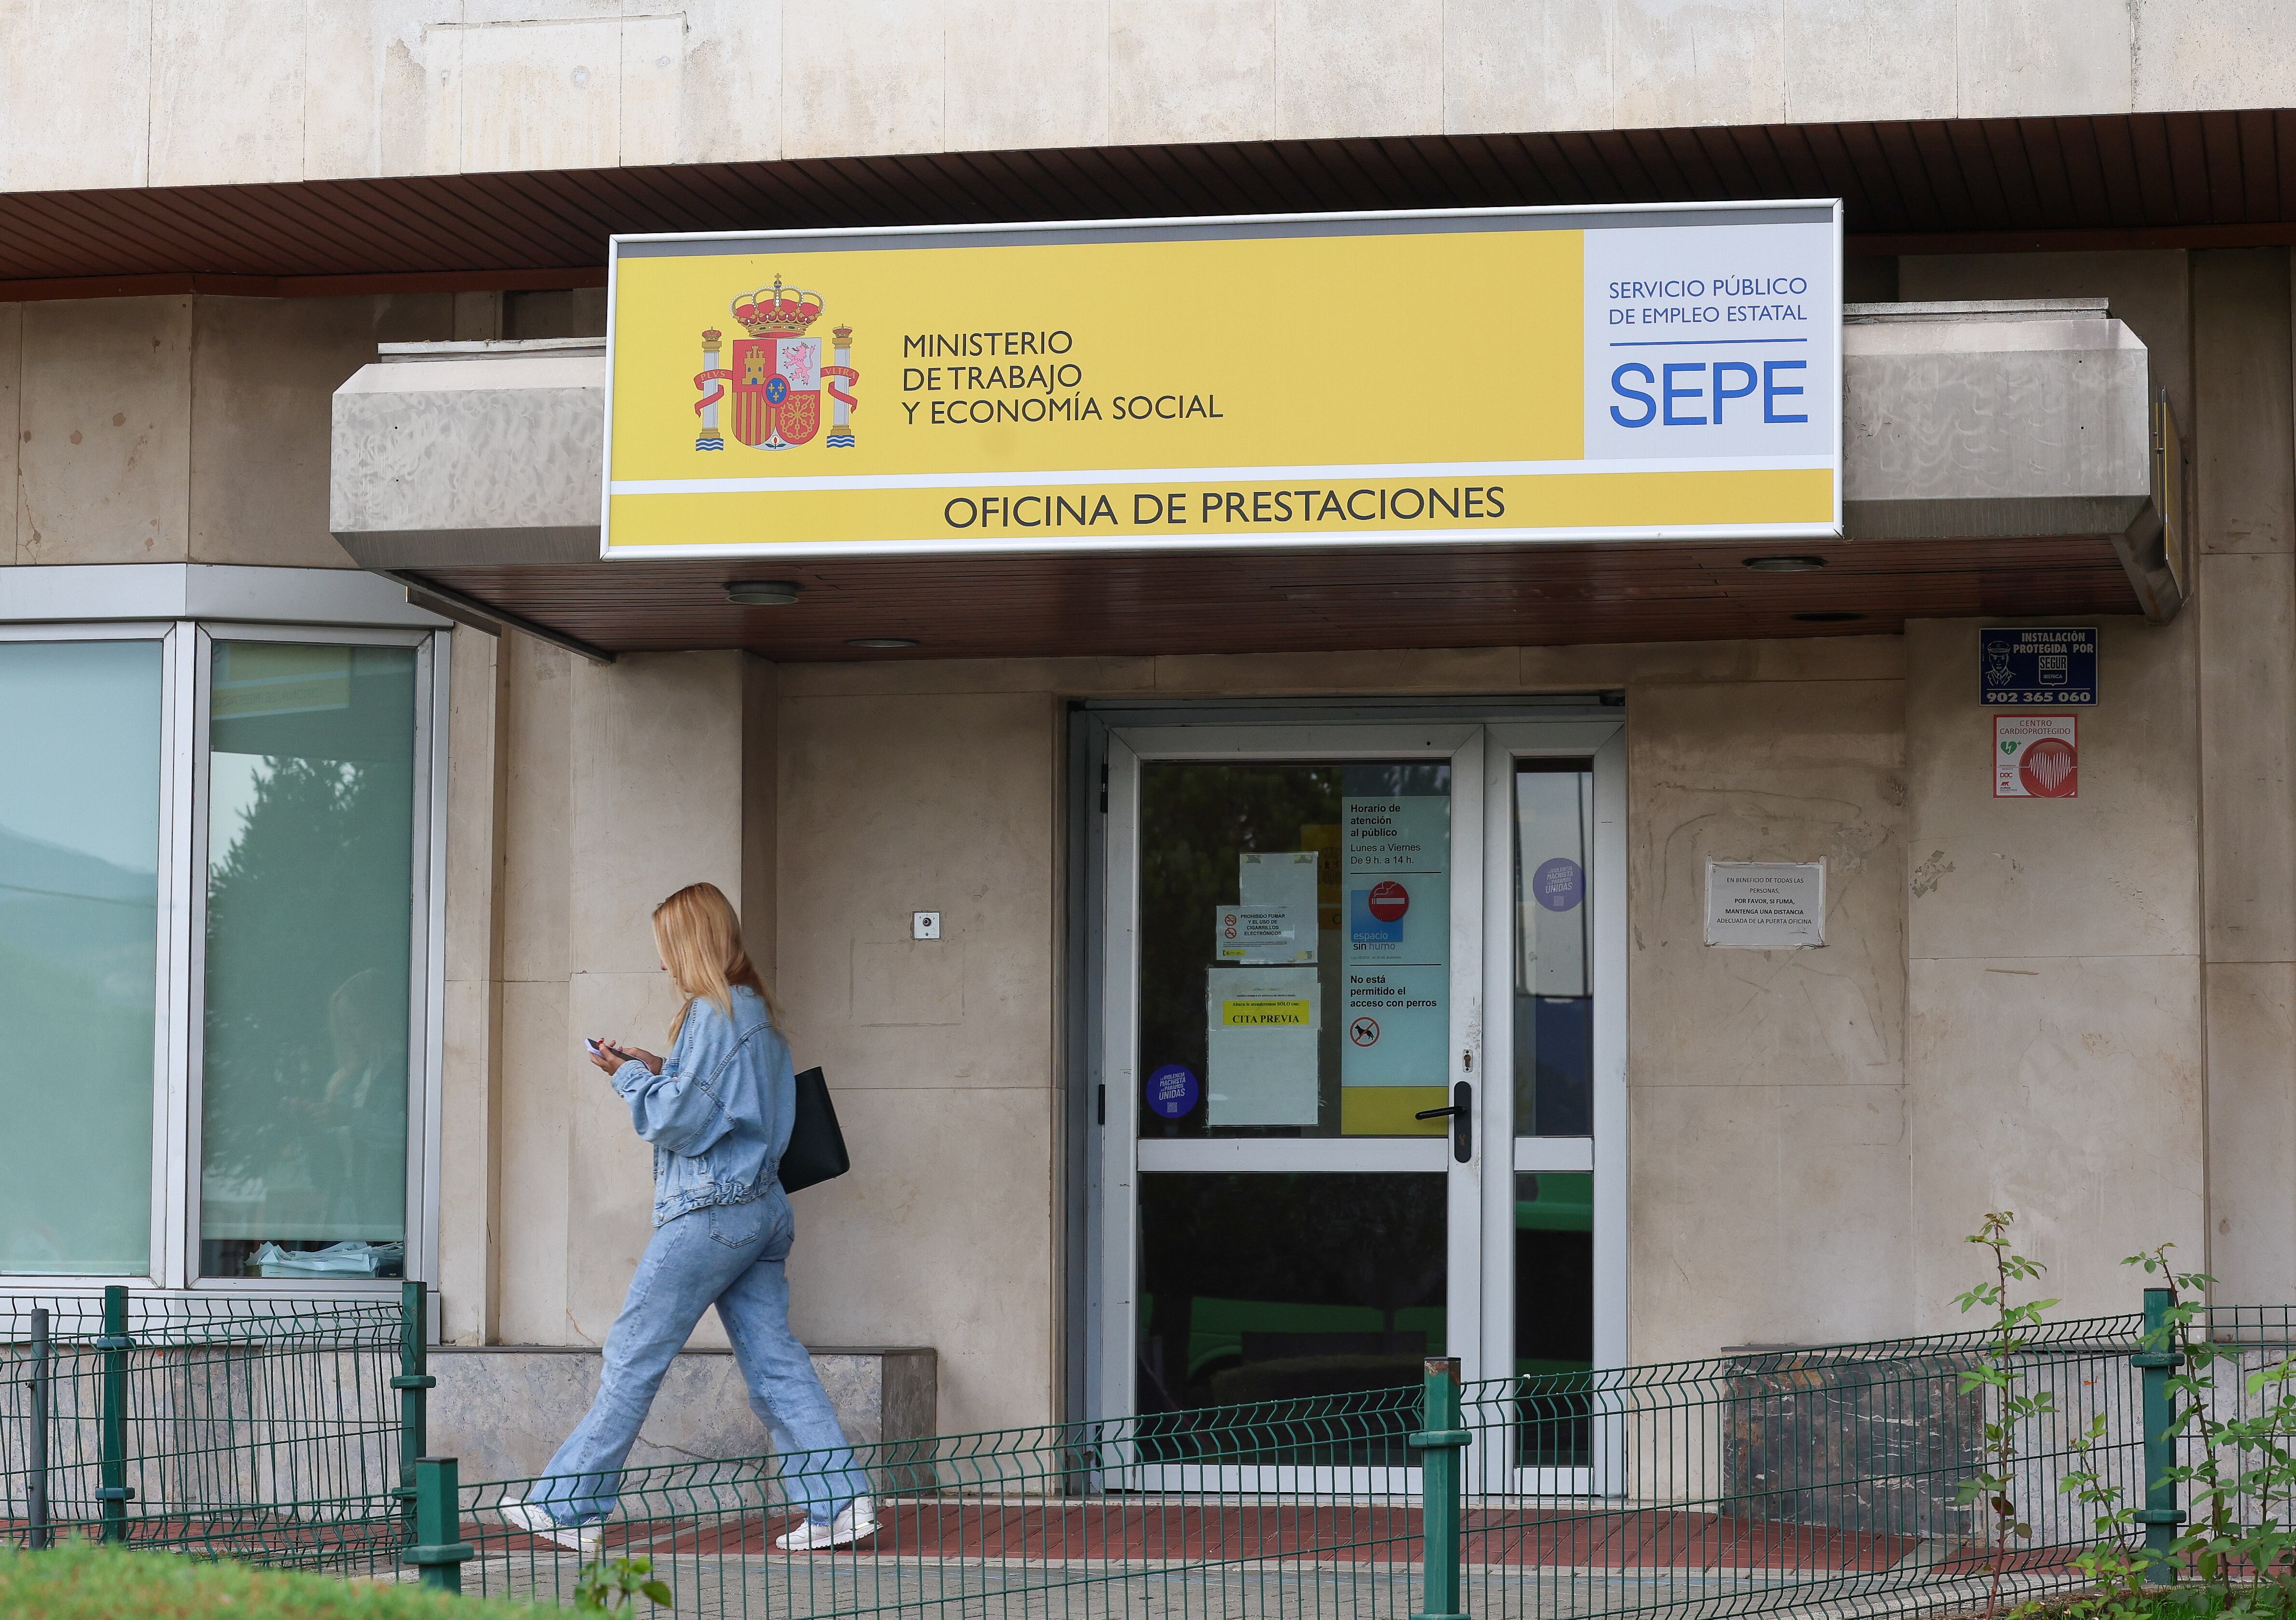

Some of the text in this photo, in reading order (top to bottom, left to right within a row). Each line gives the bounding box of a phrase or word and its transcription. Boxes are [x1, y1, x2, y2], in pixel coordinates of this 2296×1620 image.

[1610, 275, 1808, 299] SERVICIO PÚBLICO
[1610, 305, 1807, 325] DE EMPLEO ESTATAL
[904, 331, 1072, 358] MINISTERIO
[824, 367, 858, 380] VLTRA
[904, 364, 1082, 394] DE TRABAJO
[1610, 360, 1808, 428] SEPE
[902, 391, 1224, 425] Y ECONOMÍA SOCIAL
[944, 486, 1505, 527] OFICINA DE PRESTACIONES
[2022, 631, 2085, 642] INSTALACIÓN
[2013, 644, 2093, 653] PROTEGIDA POR
[2040, 656, 2066, 669] SEGUR
[1987, 692, 2090, 702] 902 365 060
[1362, 828, 1397, 838] público
[1547, 871, 1573, 880] MACHISTA
[1546, 882, 1572, 893] UNIDAS
[1353, 931, 1388, 942] espacio
[1353, 942, 1366, 950] sin
[1366, 975, 1386, 983] está
[1350, 987, 1405, 997] permitido el
[1406, 999, 1437, 1009] perros
[1232, 1014, 1300, 1023] CITA PREVIA
[1160, 1077, 1185, 1087] MACHISTA
[1159, 1088, 1185, 1101] UNIDAS
